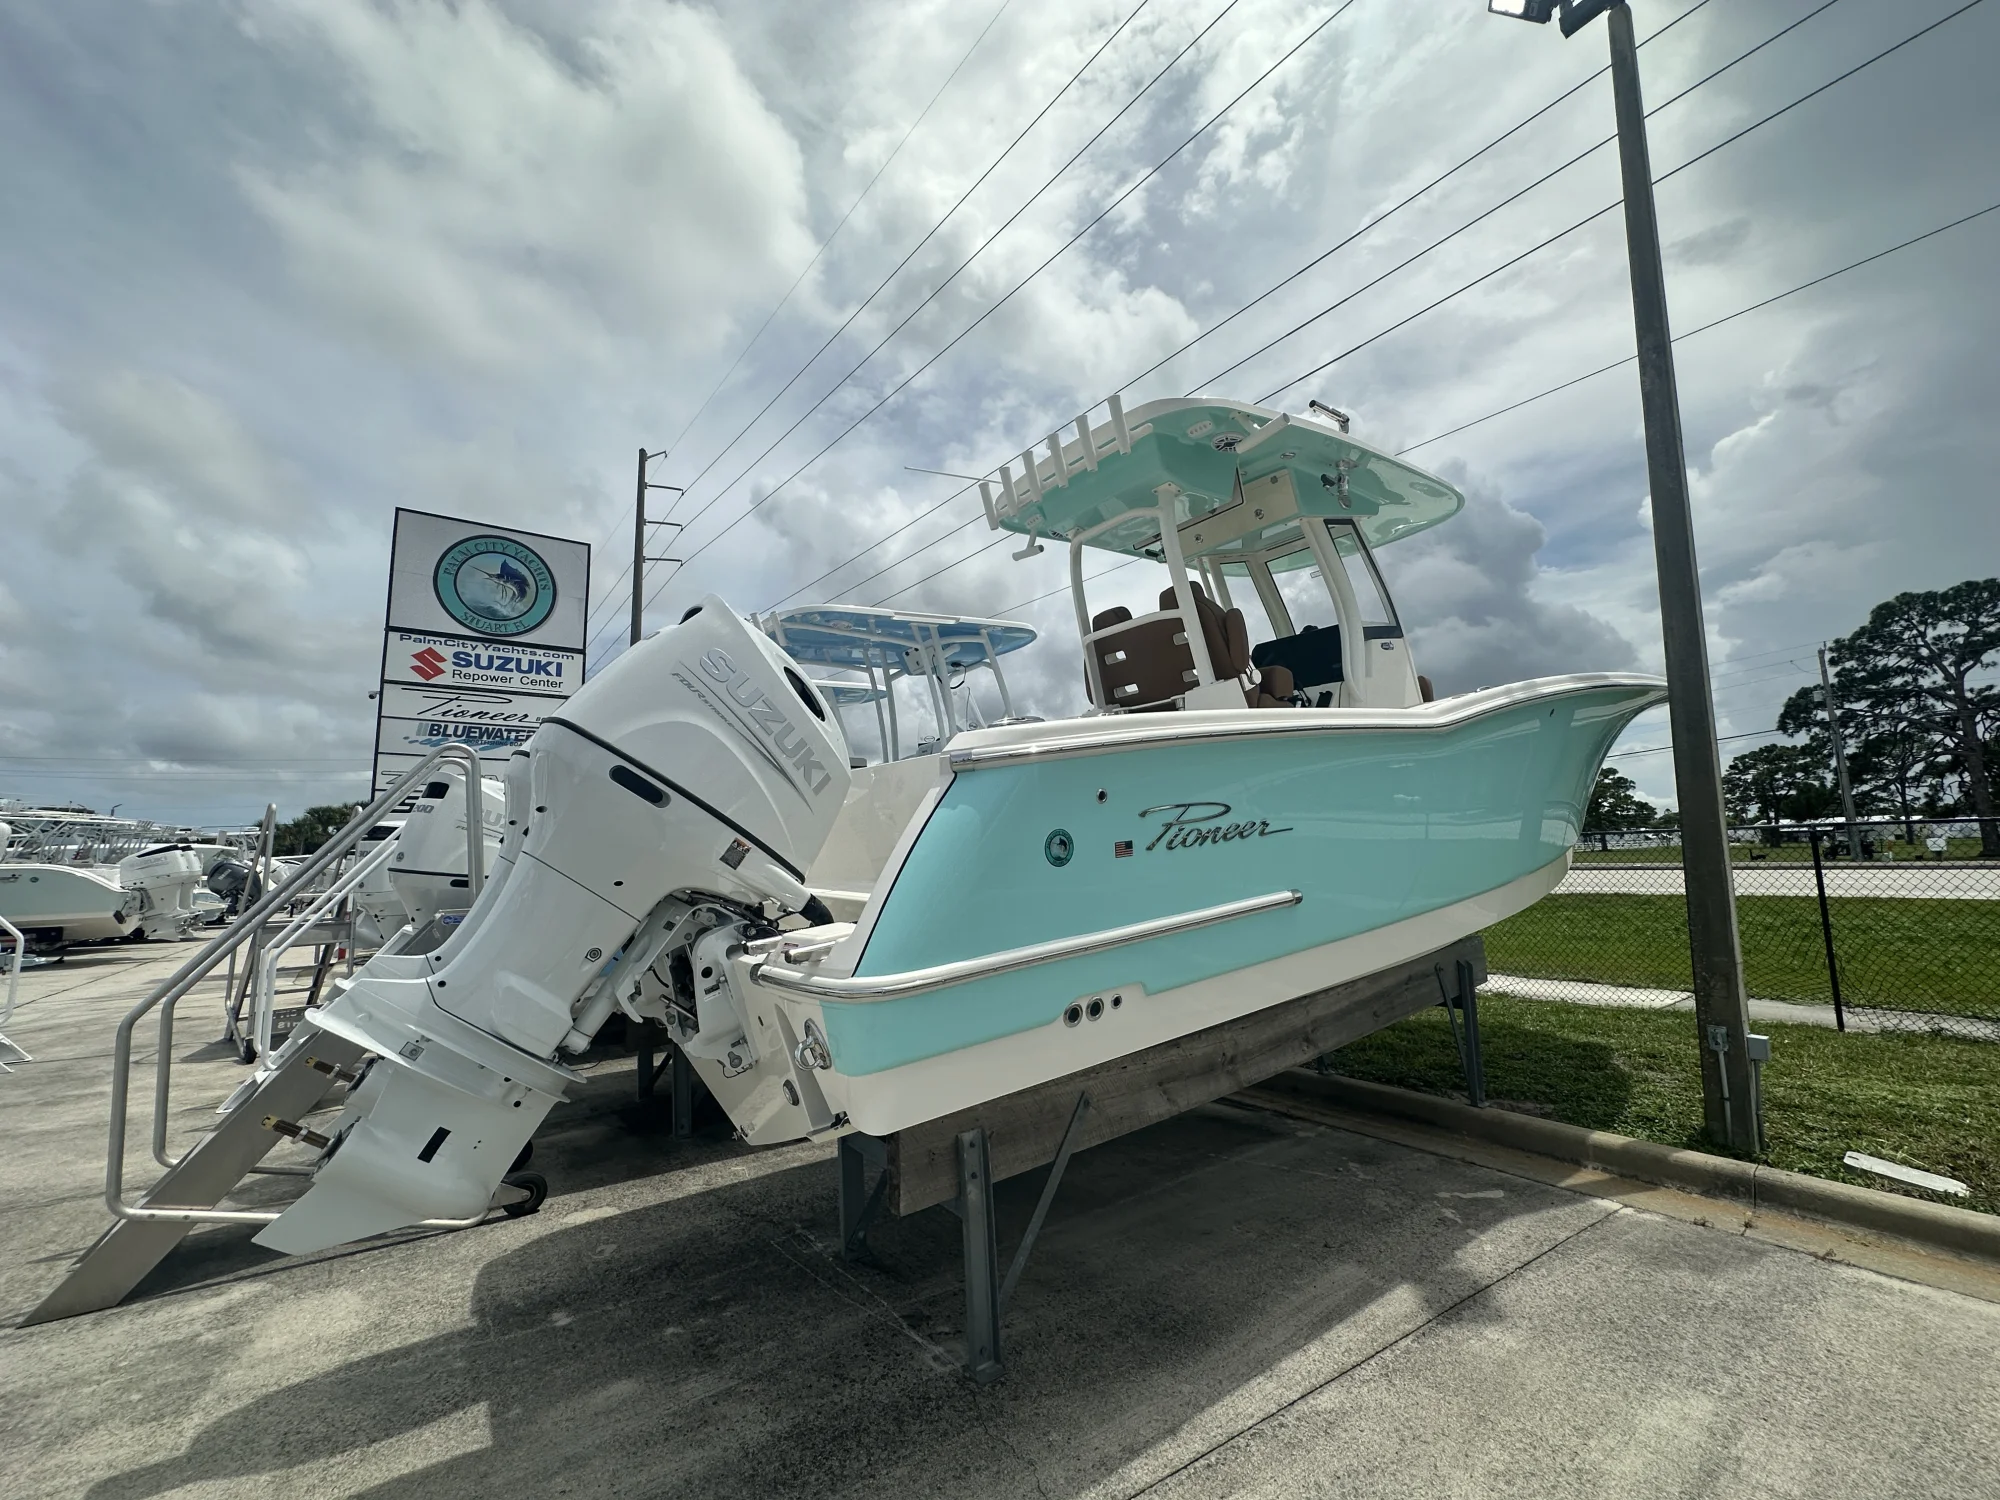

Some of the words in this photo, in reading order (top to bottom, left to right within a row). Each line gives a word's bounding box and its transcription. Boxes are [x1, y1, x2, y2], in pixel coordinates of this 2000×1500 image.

[444, 549, 474, 576] PALM
[475, 540, 509, 553] CITY
[513, 545, 550, 591] YACHTS
[515, 619, 530, 631] FL
[452, 651, 563, 678] SUZUKI
[452, 669, 515, 684] Repower
[520, 676, 564, 689] Center
[401, 687, 542, 724] Pioneer
[700, 648, 831, 796] SUZUKI
[1138, 801, 1293, 851] Pioneer
